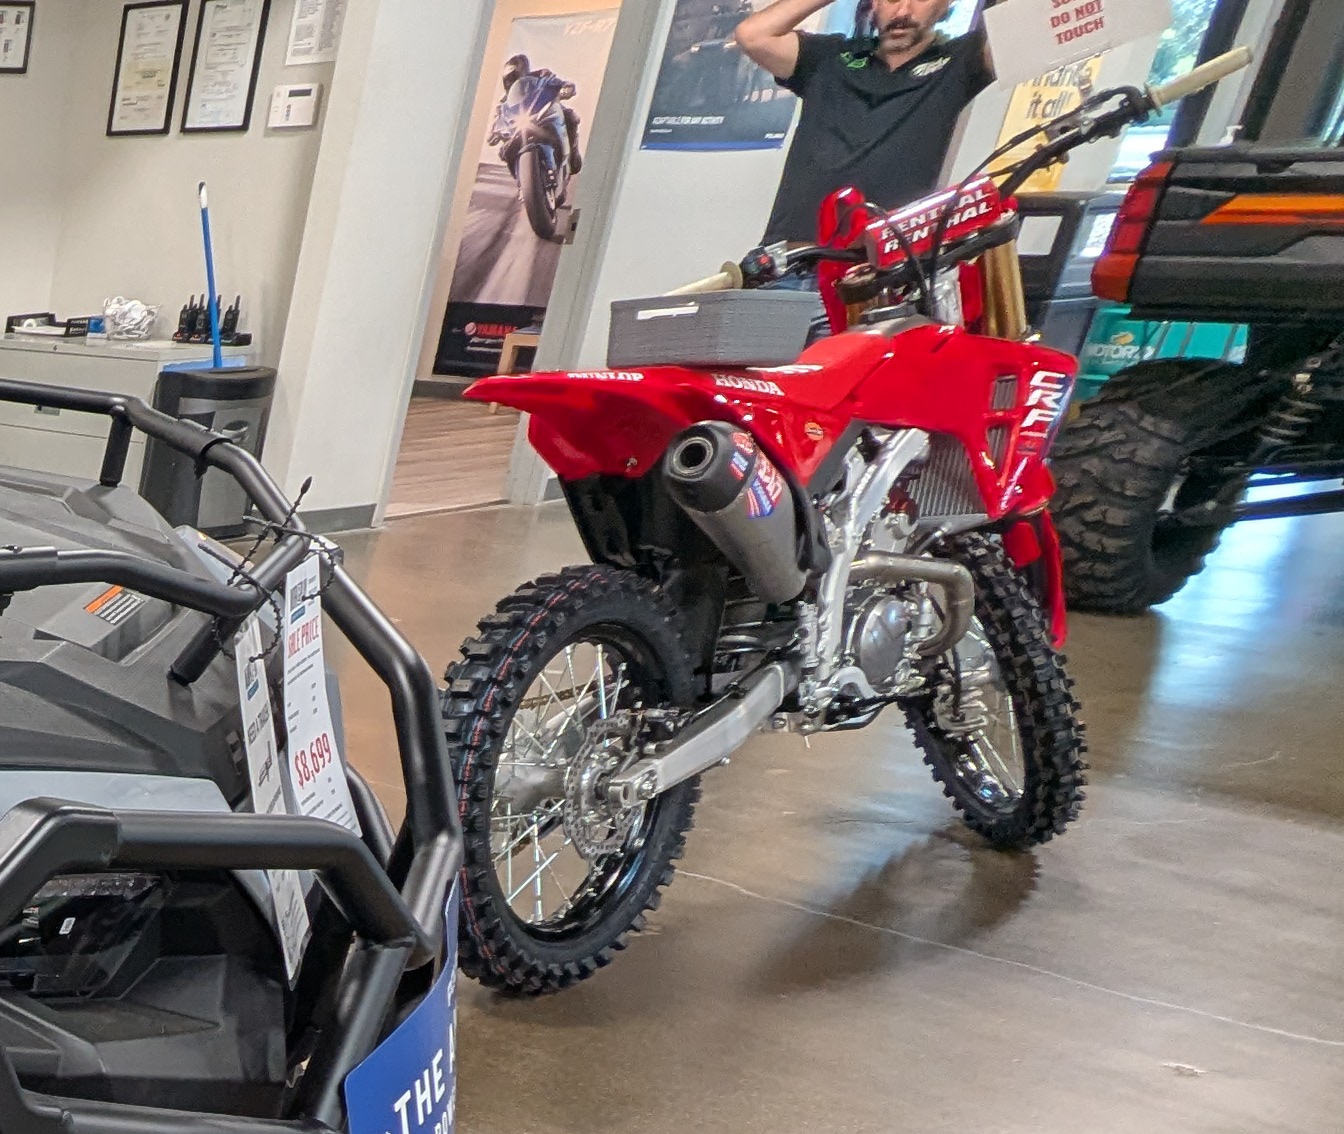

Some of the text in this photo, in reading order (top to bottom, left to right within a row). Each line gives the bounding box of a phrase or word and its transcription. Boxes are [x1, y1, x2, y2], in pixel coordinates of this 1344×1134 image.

[1050, 12, 1070, 28] DO
[1075, 0, 1103, 19] NOT
[1054, 16, 1105, 45] TOUCH
[714, 374, 785, 396] HONDA
[294, 731, 333, 790] $8,699
